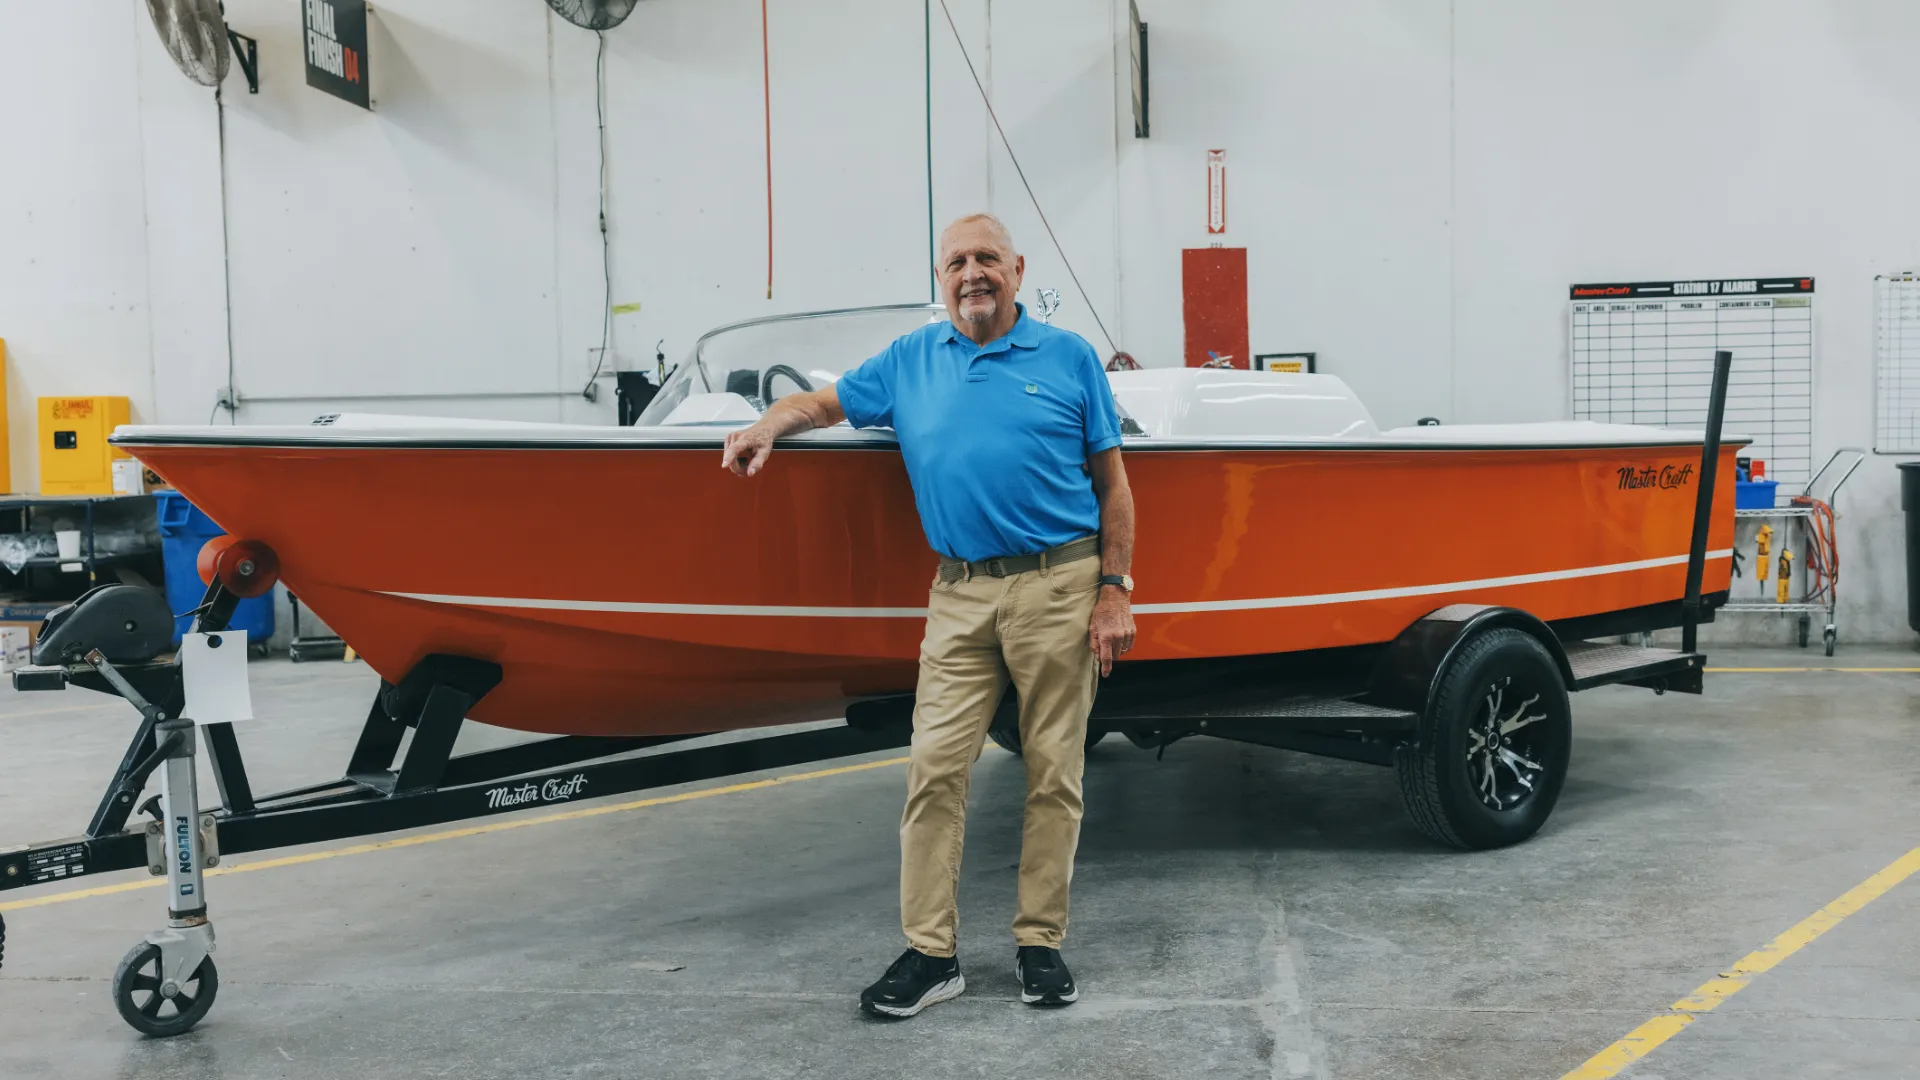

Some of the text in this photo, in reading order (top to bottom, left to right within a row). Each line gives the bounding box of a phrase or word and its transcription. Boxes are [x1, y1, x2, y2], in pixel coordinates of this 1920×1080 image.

[306, 0, 337, 41] FINAL
[307, 28, 359, 85] FINISH 04
[1673, 280, 1757, 295] STATION 17 ALARMS
[1616, 464, 1694, 490] Master Craft
[485, 773, 588, 808] Master Craft
[176, 816, 192, 874] FULTON
